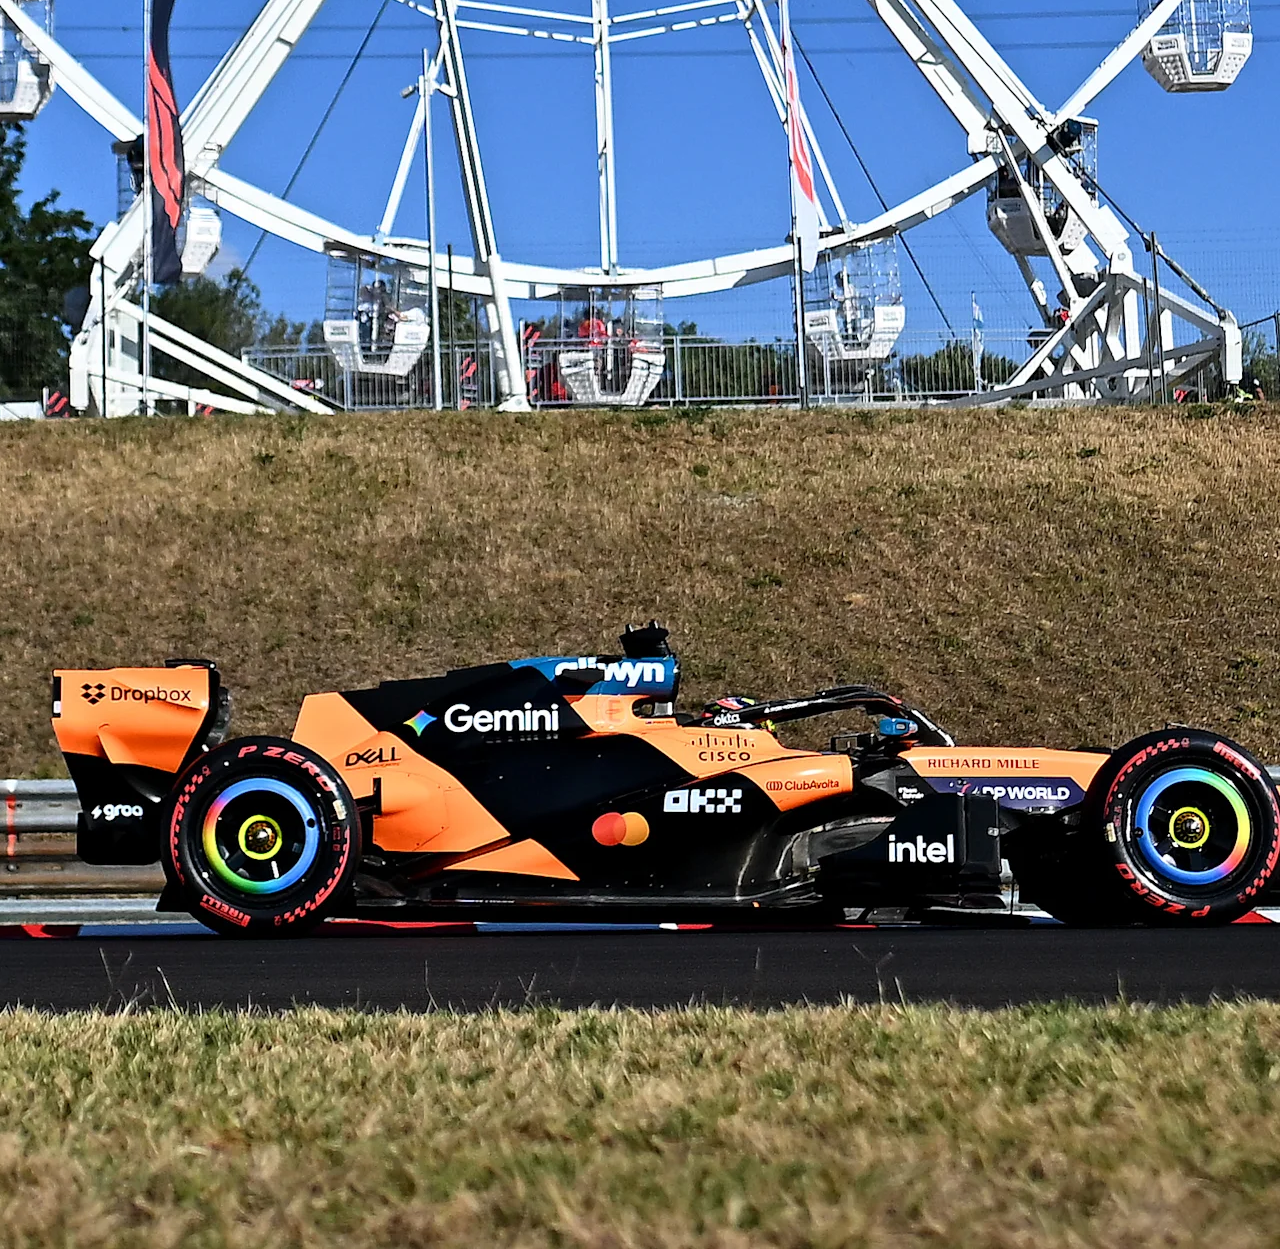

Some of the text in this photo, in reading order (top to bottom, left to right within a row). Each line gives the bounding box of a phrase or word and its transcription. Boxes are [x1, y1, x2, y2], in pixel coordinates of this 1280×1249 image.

[111, 686, 191, 704] Dropbox
[444, 702, 559, 733] Gemini
[714, 713, 740, 726] okta
[345, 747, 401, 767] DELL
[698, 751, 751, 761] CISCO
[928, 759, 1040, 769] RICHARD MILLE
[1213, 741, 1262, 780] PIRELLI
[238, 745, 334, 792] P ZERO
[663, 789, 742, 813] OKX
[1007, 787, 1070, 800] WORLD
[888, 834, 954, 863] intel
[1116, 863, 1211, 918] P ZERO
